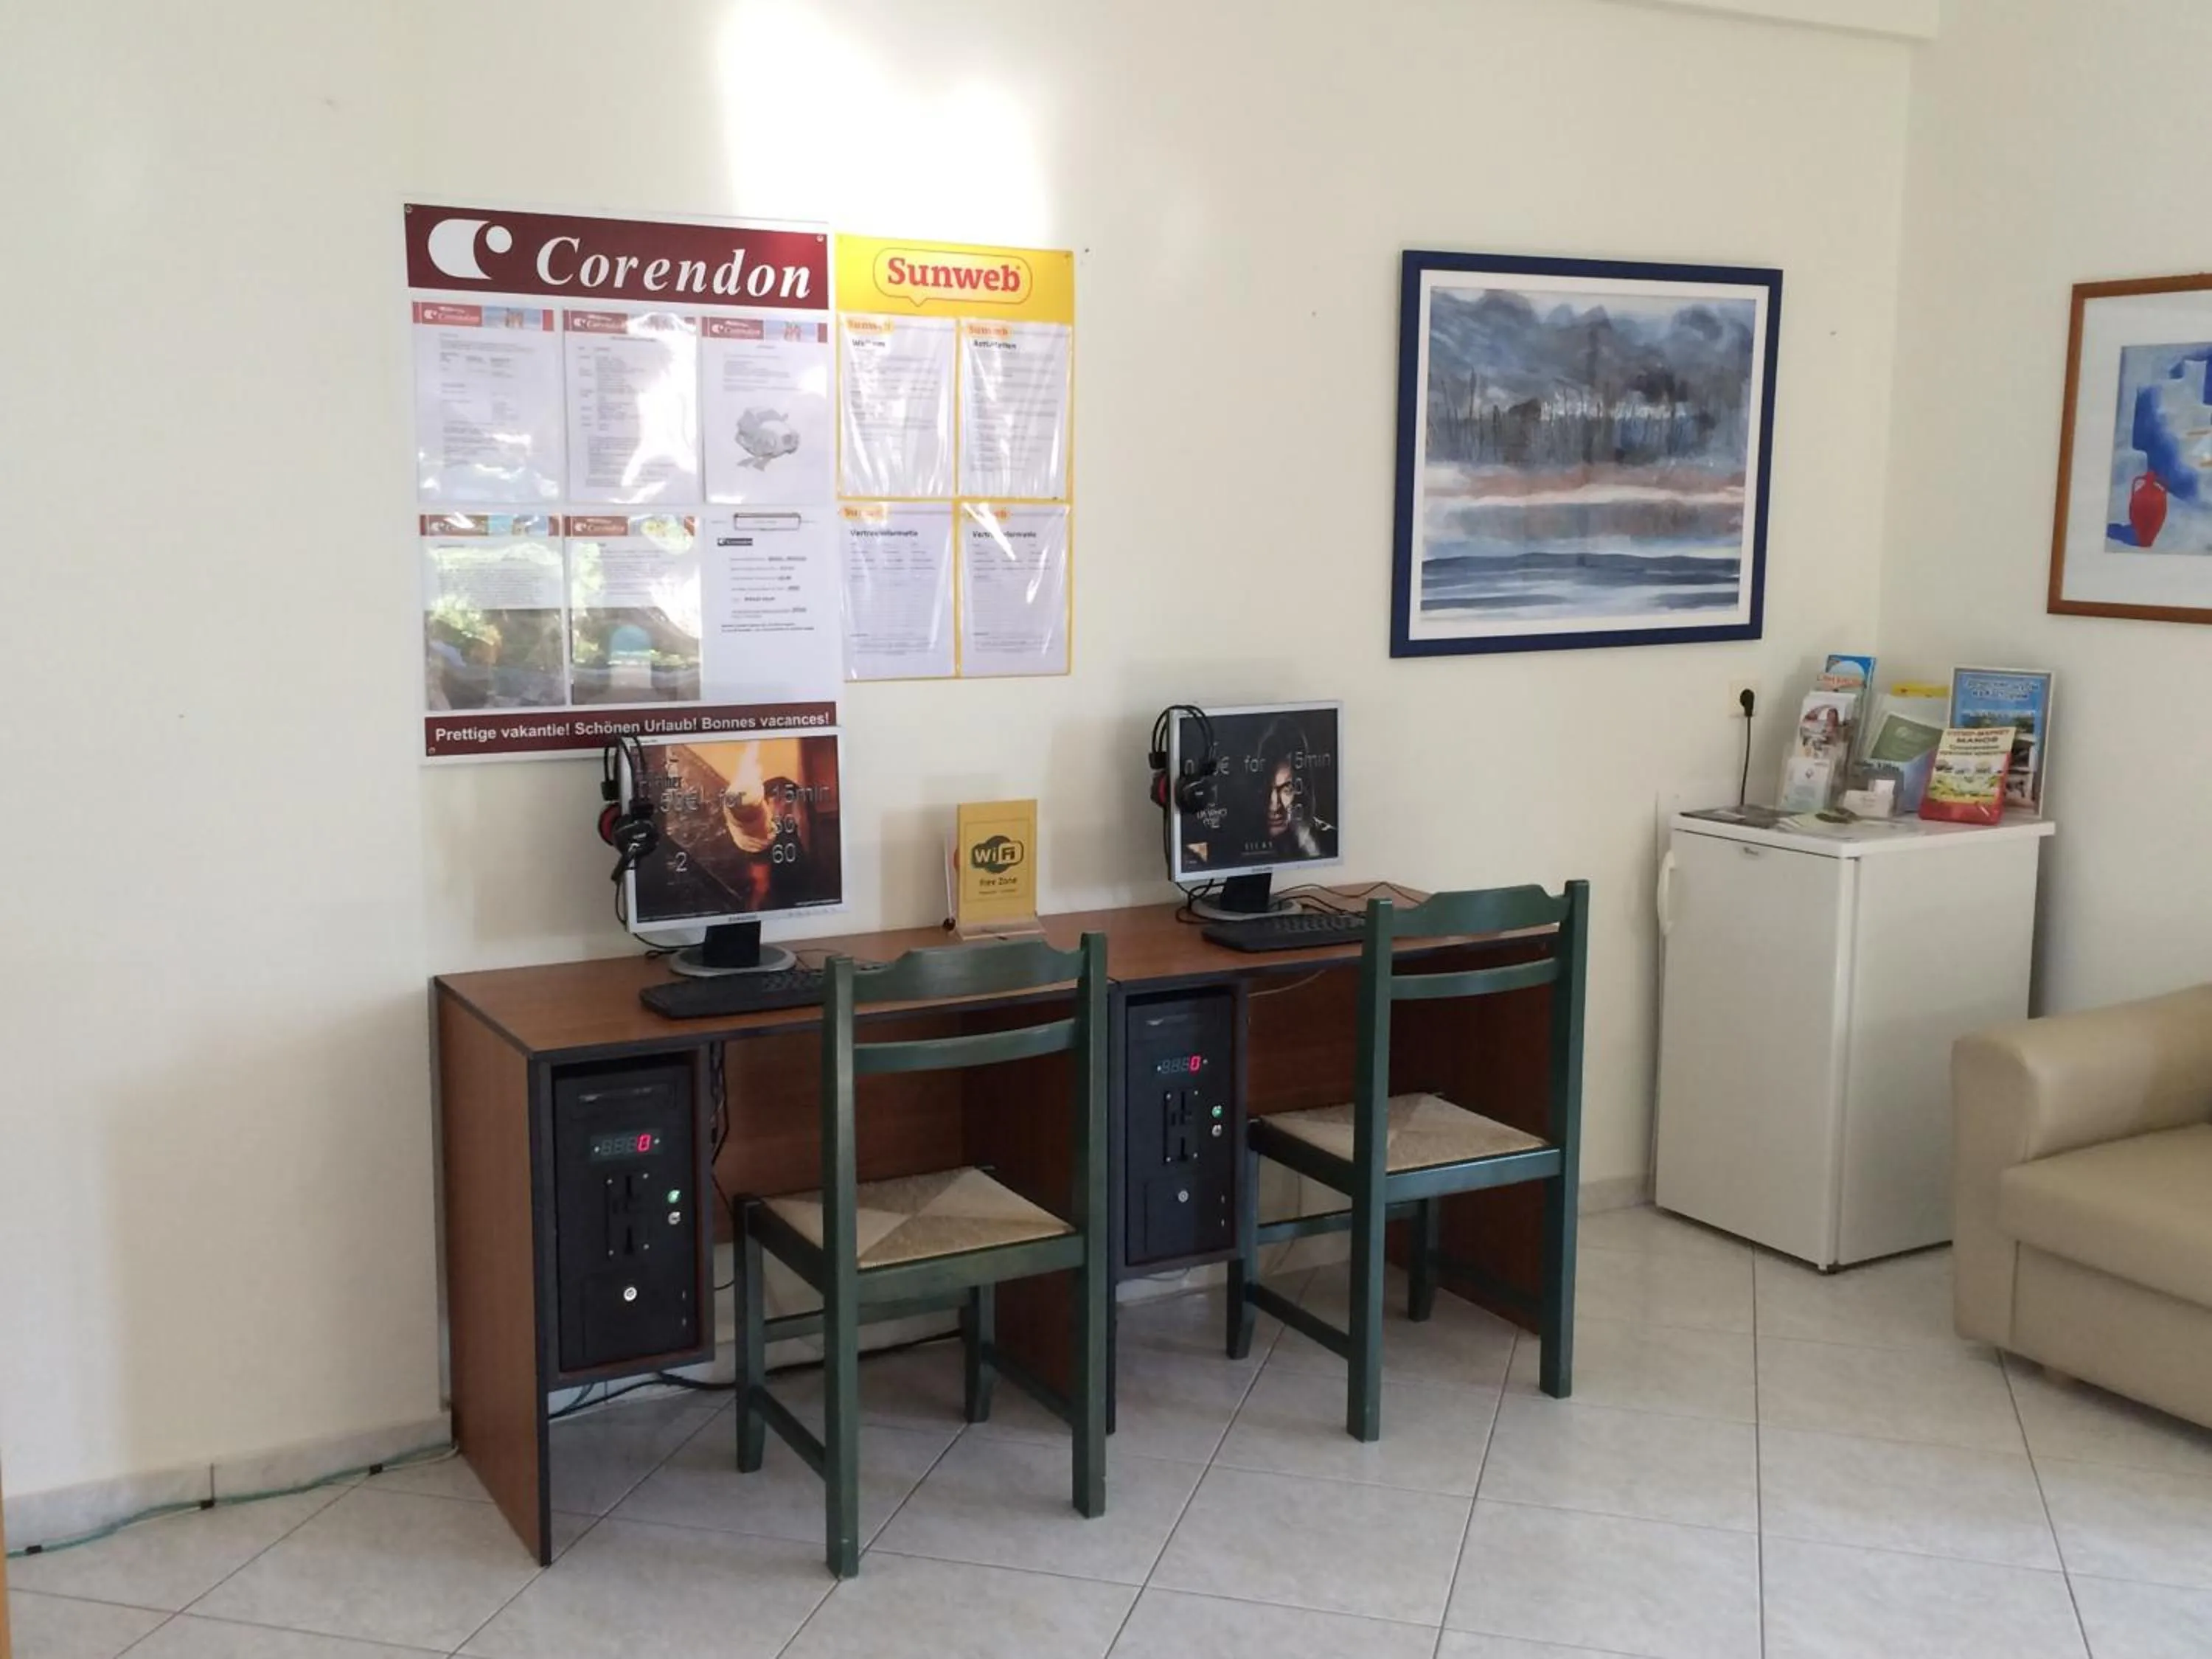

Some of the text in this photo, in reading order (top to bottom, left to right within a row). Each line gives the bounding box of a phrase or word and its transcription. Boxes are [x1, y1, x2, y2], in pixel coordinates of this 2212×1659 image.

[536, 236, 810, 298] Corendon
[888, 257, 1020, 293] Sunweb
[435, 712, 829, 742] Prettige vakantie! Schönen Urlaub! Bonnes vacances!
[772, 843, 796, 863] 60
